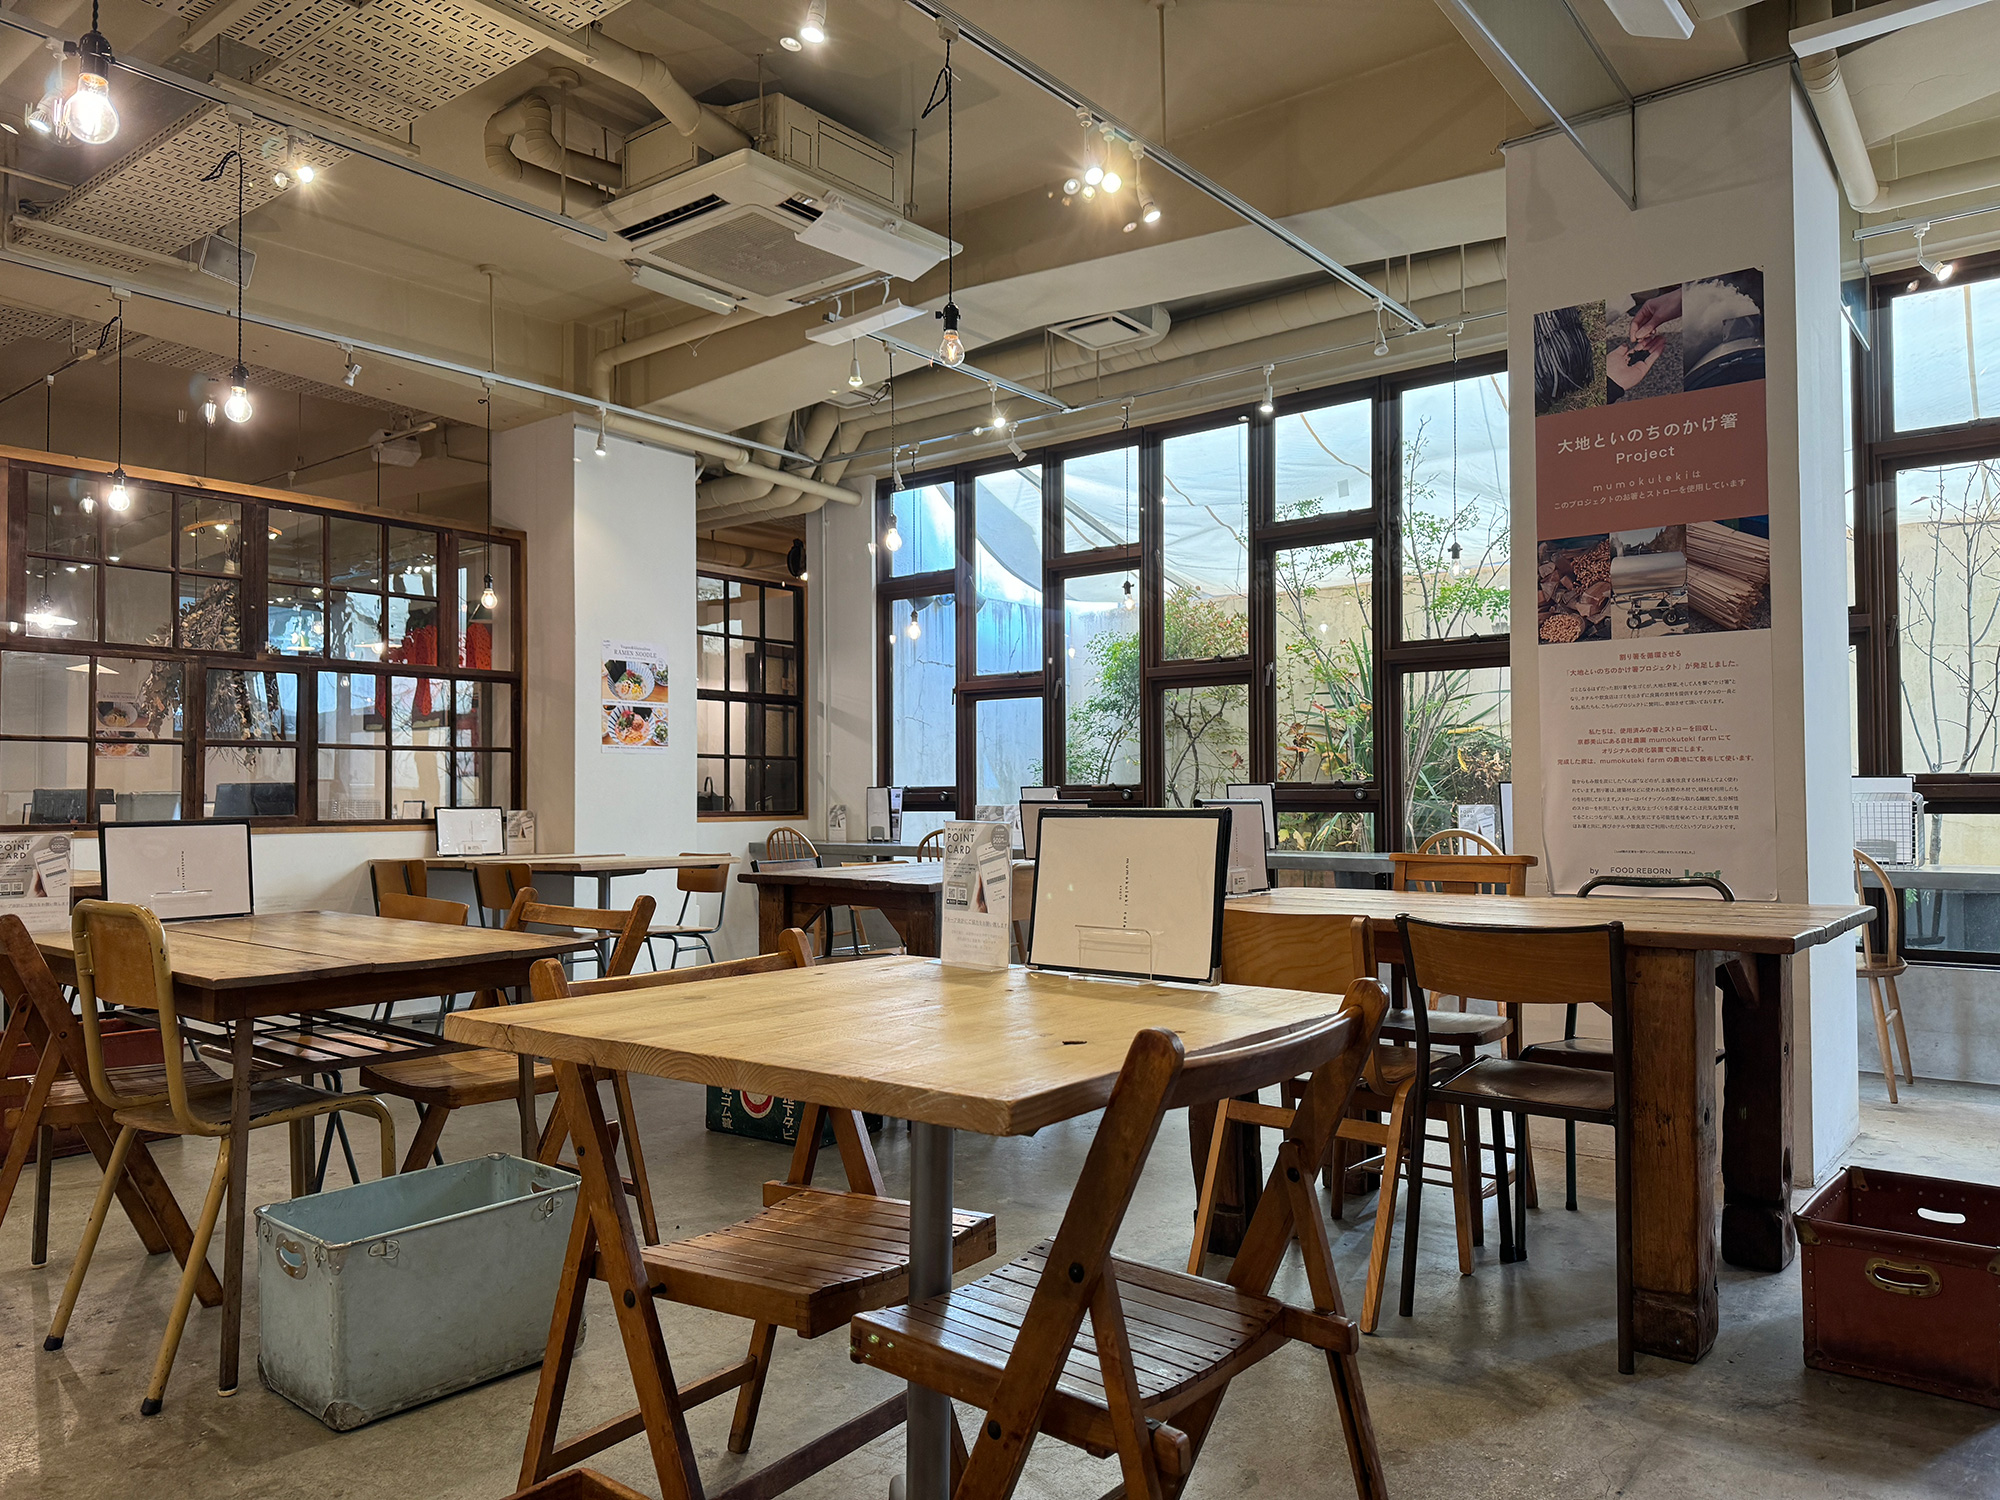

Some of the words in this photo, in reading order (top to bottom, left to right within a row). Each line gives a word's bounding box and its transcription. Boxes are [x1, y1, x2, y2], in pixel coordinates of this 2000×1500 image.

[1557, 412, 1738, 455] 大地といのちのかけ箸
[1616, 446, 1675, 464] Project
[1592, 470, 1701, 492] mumokutekiは
[1553, 478, 1746, 510] このプロジェクトのお箸とストローを使用しています
[1619, 650, 1682, 661] 割り箸を循環させる
[1649, 736, 1696, 744] mumokuteki
[1698, 735, 1717, 743] farm
[1718, 734, 1732, 742] にて
[1600, 756, 1645, 765] mumokuteki
[947, 832, 975, 843] POINT
[947, 844, 971, 855] CARD
[1589, 867, 1600, 876] by
[1610, 867, 1634, 875] FOOD
[1636, 867, 1672, 875] REBORN
